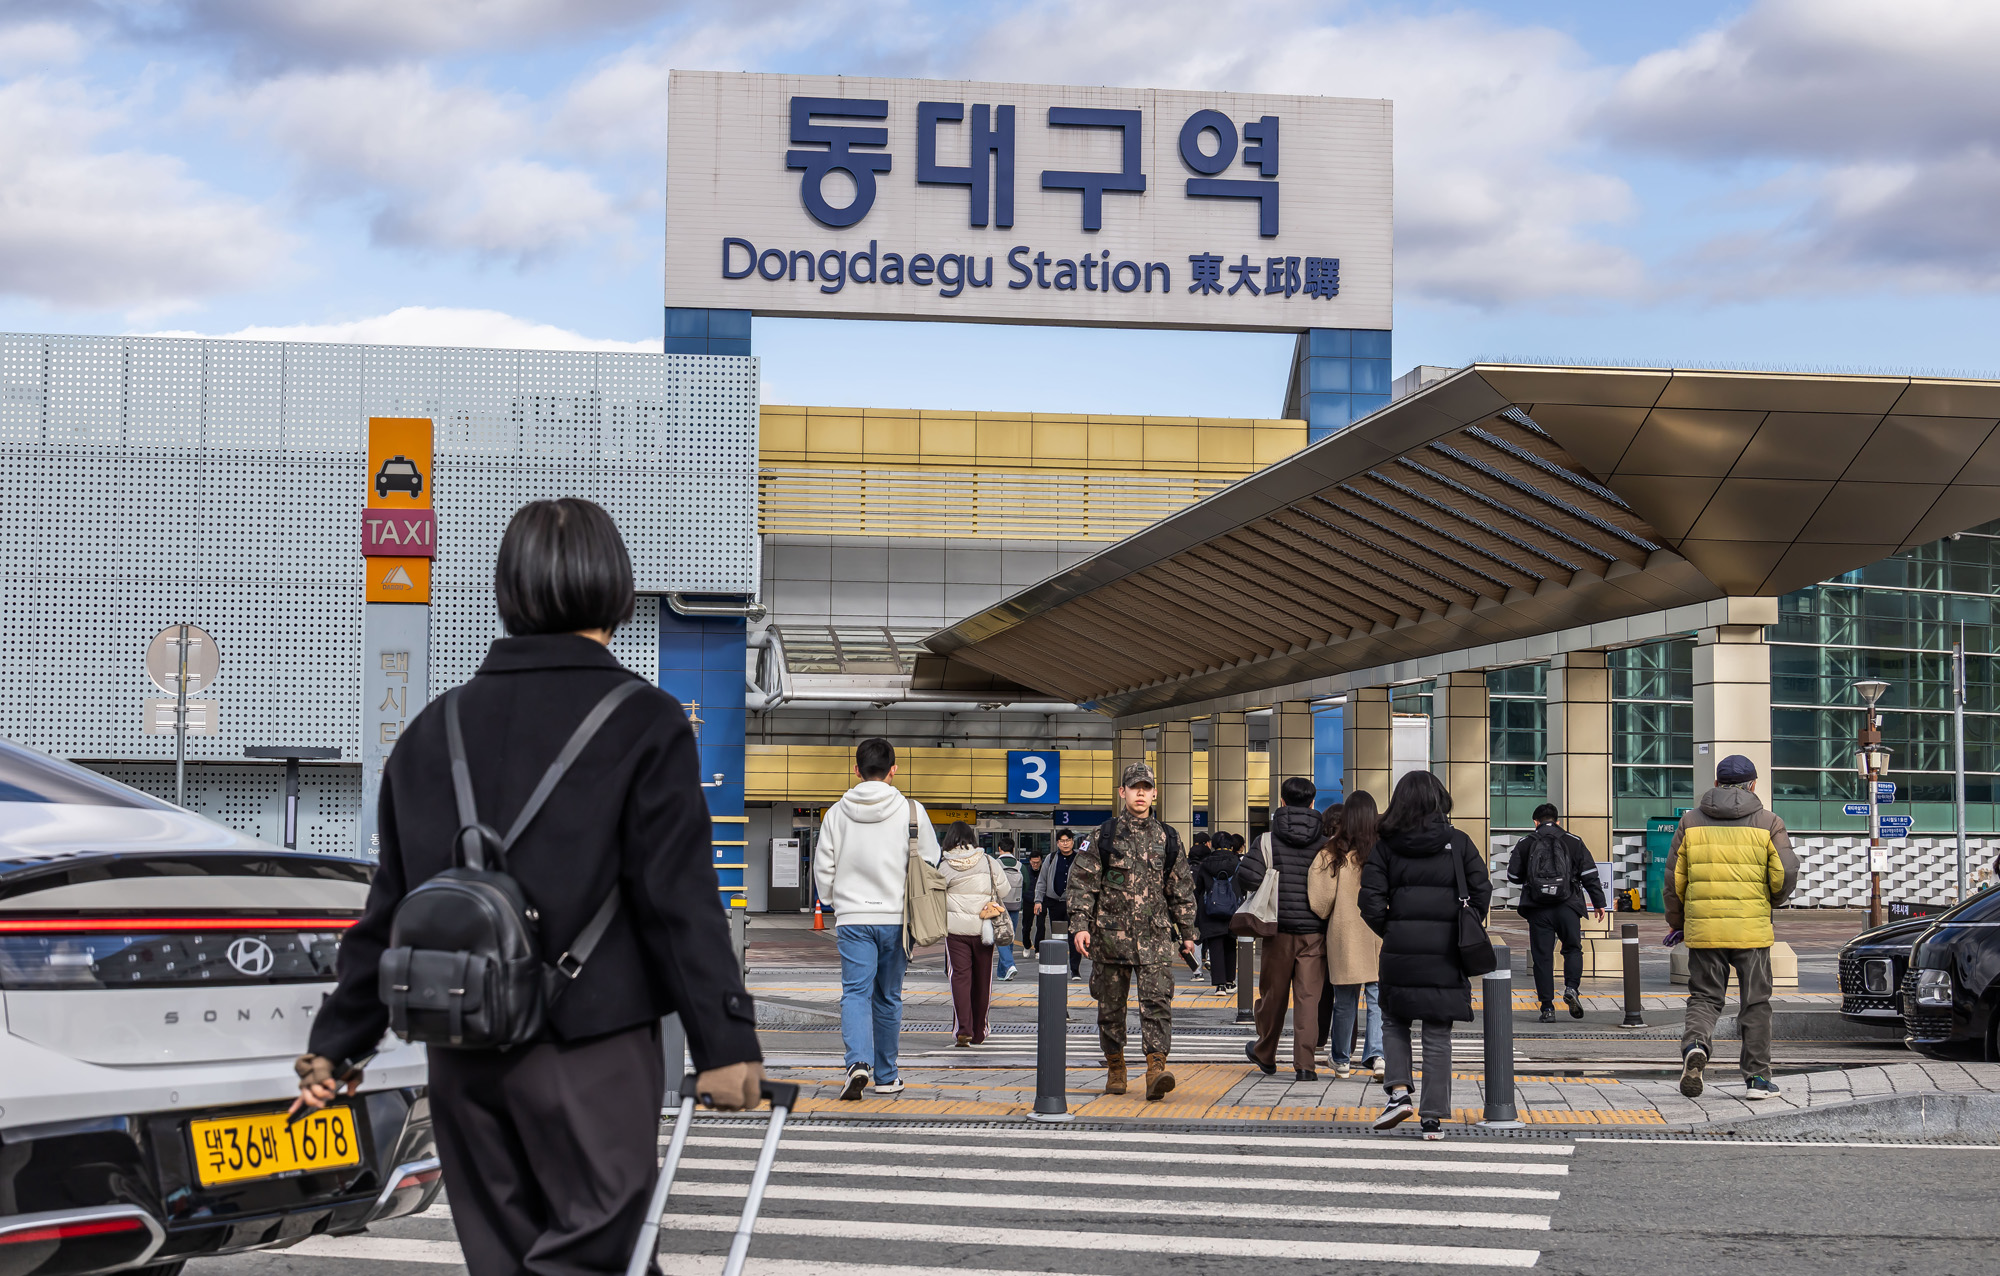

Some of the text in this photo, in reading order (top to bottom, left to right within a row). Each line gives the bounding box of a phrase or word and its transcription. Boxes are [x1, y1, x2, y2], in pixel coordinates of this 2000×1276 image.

[787, 96, 1279, 238] 동대구역
[722, 238, 1340, 299] Dongdaegu Station 東大邱驛
[366, 519, 431, 546] TAXI
[1020, 756, 1048, 799] 3
[1062, 811, 1070, 824] 3
[1891, 903, 1909, 916] 기후시계
[164, 1006, 314, 1025] SONAT
[284, 1115, 348, 1163] 1678
